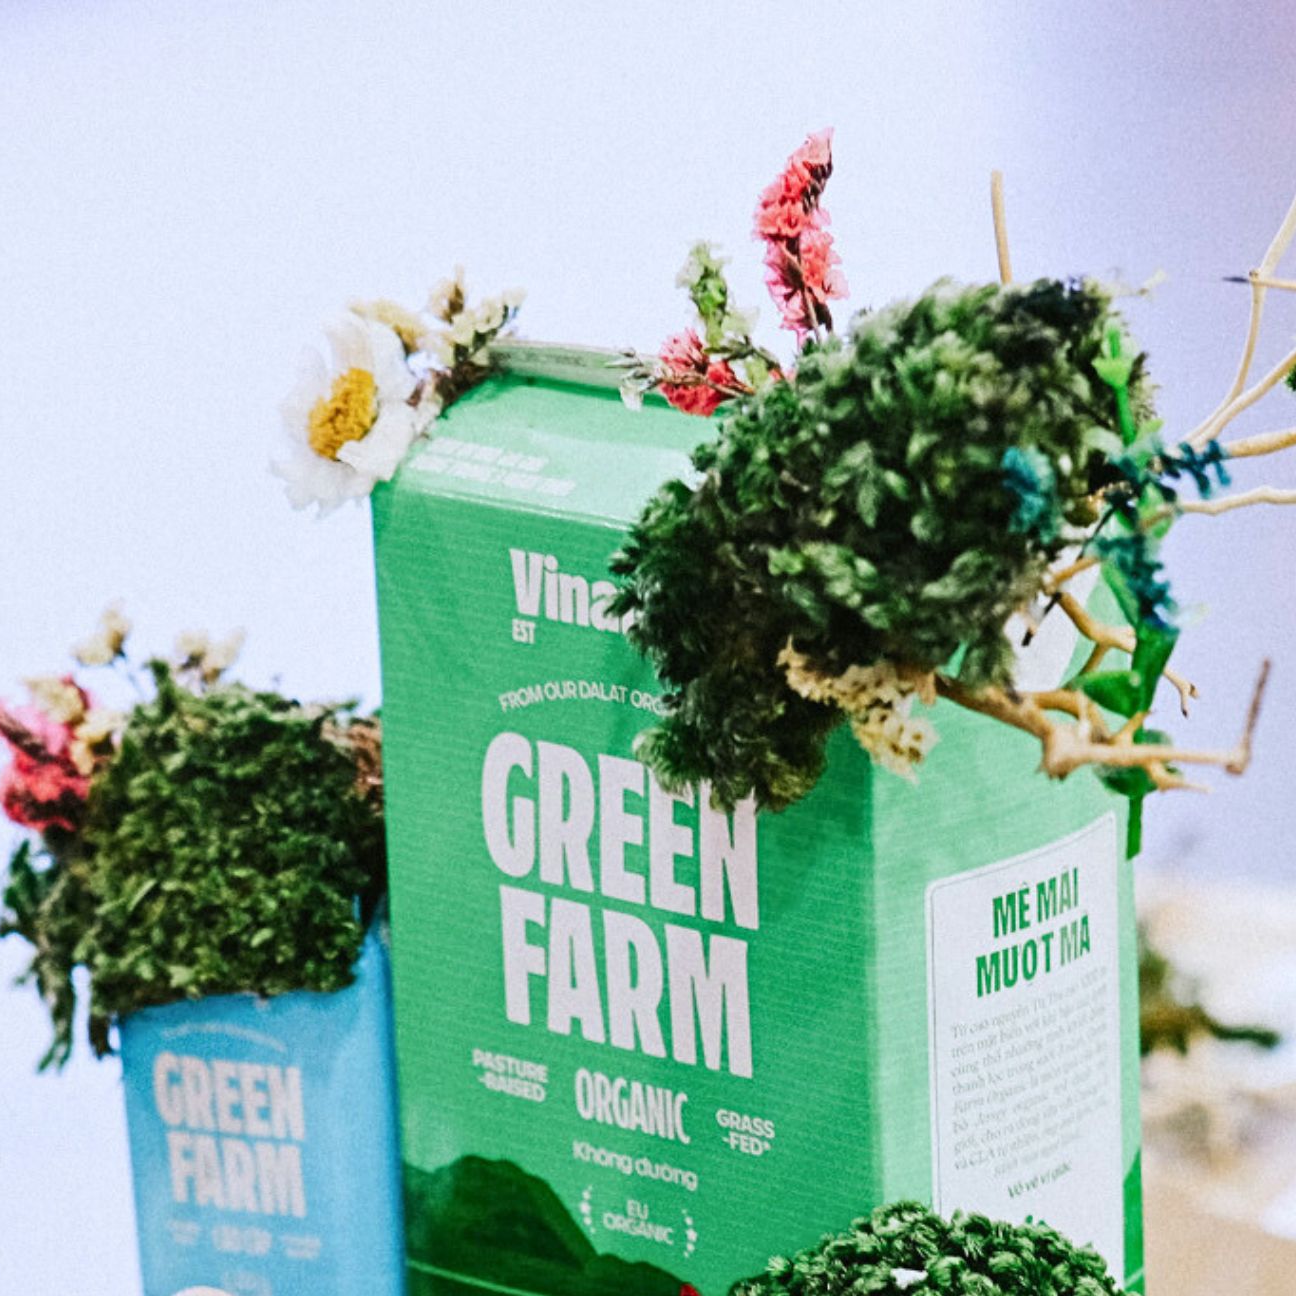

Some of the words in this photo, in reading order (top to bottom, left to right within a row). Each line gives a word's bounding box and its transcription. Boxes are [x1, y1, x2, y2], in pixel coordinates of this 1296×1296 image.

[509, 547, 636, 636] Vina
[511, 617, 537, 645] EST
[499, 686, 545, 714] FROM
[544, 680, 578, 701] OUR
[630, 689, 677, 717] ORG
[481, 731, 760, 931] GREEN
[498, 884, 754, 1080] FARM
[153, 1051, 305, 1142] GREEN
[471, 1047, 549, 1084] PASTURE
[574, 1067, 691, 1145] ORGANIC
[715, 1108, 776, 1139] GRASS
[165, 1131, 307, 1219] FARM
[603, 1211, 675, 1246] ORGANIC
